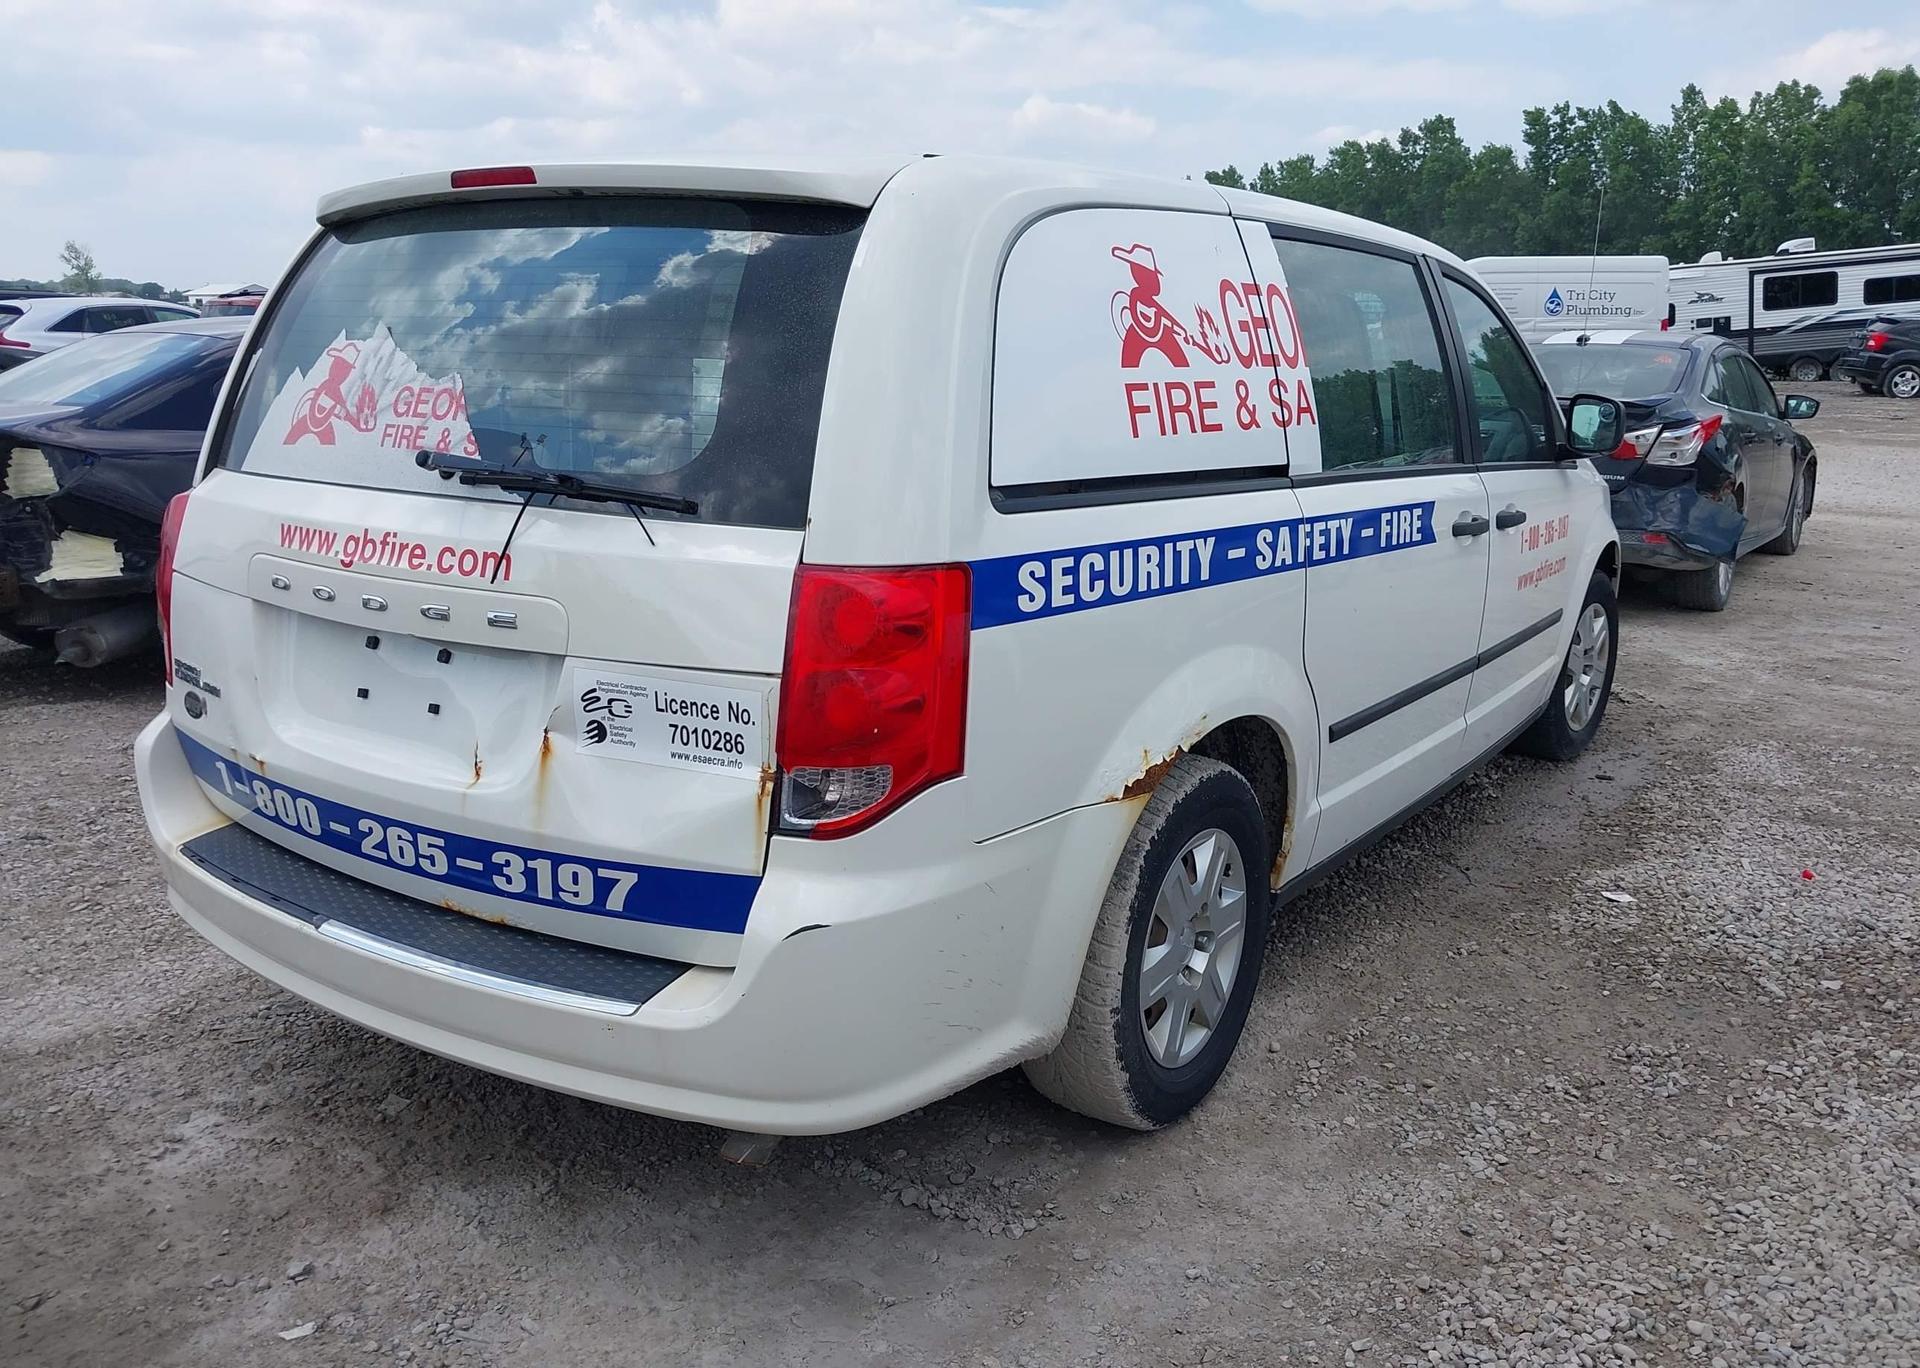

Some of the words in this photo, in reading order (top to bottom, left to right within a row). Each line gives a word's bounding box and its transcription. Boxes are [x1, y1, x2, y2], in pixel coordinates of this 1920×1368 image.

[1566, 289, 1586, 301] Tri
[1588, 289, 1616, 302] City
[1565, 304, 1632, 317] Plumbing
[1124, 381, 1223, 438] FIRE
[1235, 379, 1261, 430] &
[380, 423, 429, 451] FIRE
[435, 427, 452, 453] &
[279, 522, 513, 582] www.gbfire.com
[1017, 536, 1215, 613] SECURITY
[1255, 517, 1354, 571] SAFETY
[1379, 508, 1423, 548] FIRE
[271, 573, 518, 630] DODGE
[596, 680, 619, 688] Electrical
[629, 690, 649, 699] Agency
[654, 690, 720, 721] Licence
[727, 700, 756, 726] No.
[609, 724, 633, 732] Electrical
[609, 730, 627, 739] Safety
[668, 723, 745, 755] 7010286
[610, 738, 636, 748] Authority
[670, 750, 743, 770] www.esaecra.info
[215, 760, 639, 912] 1-800-265-3197
